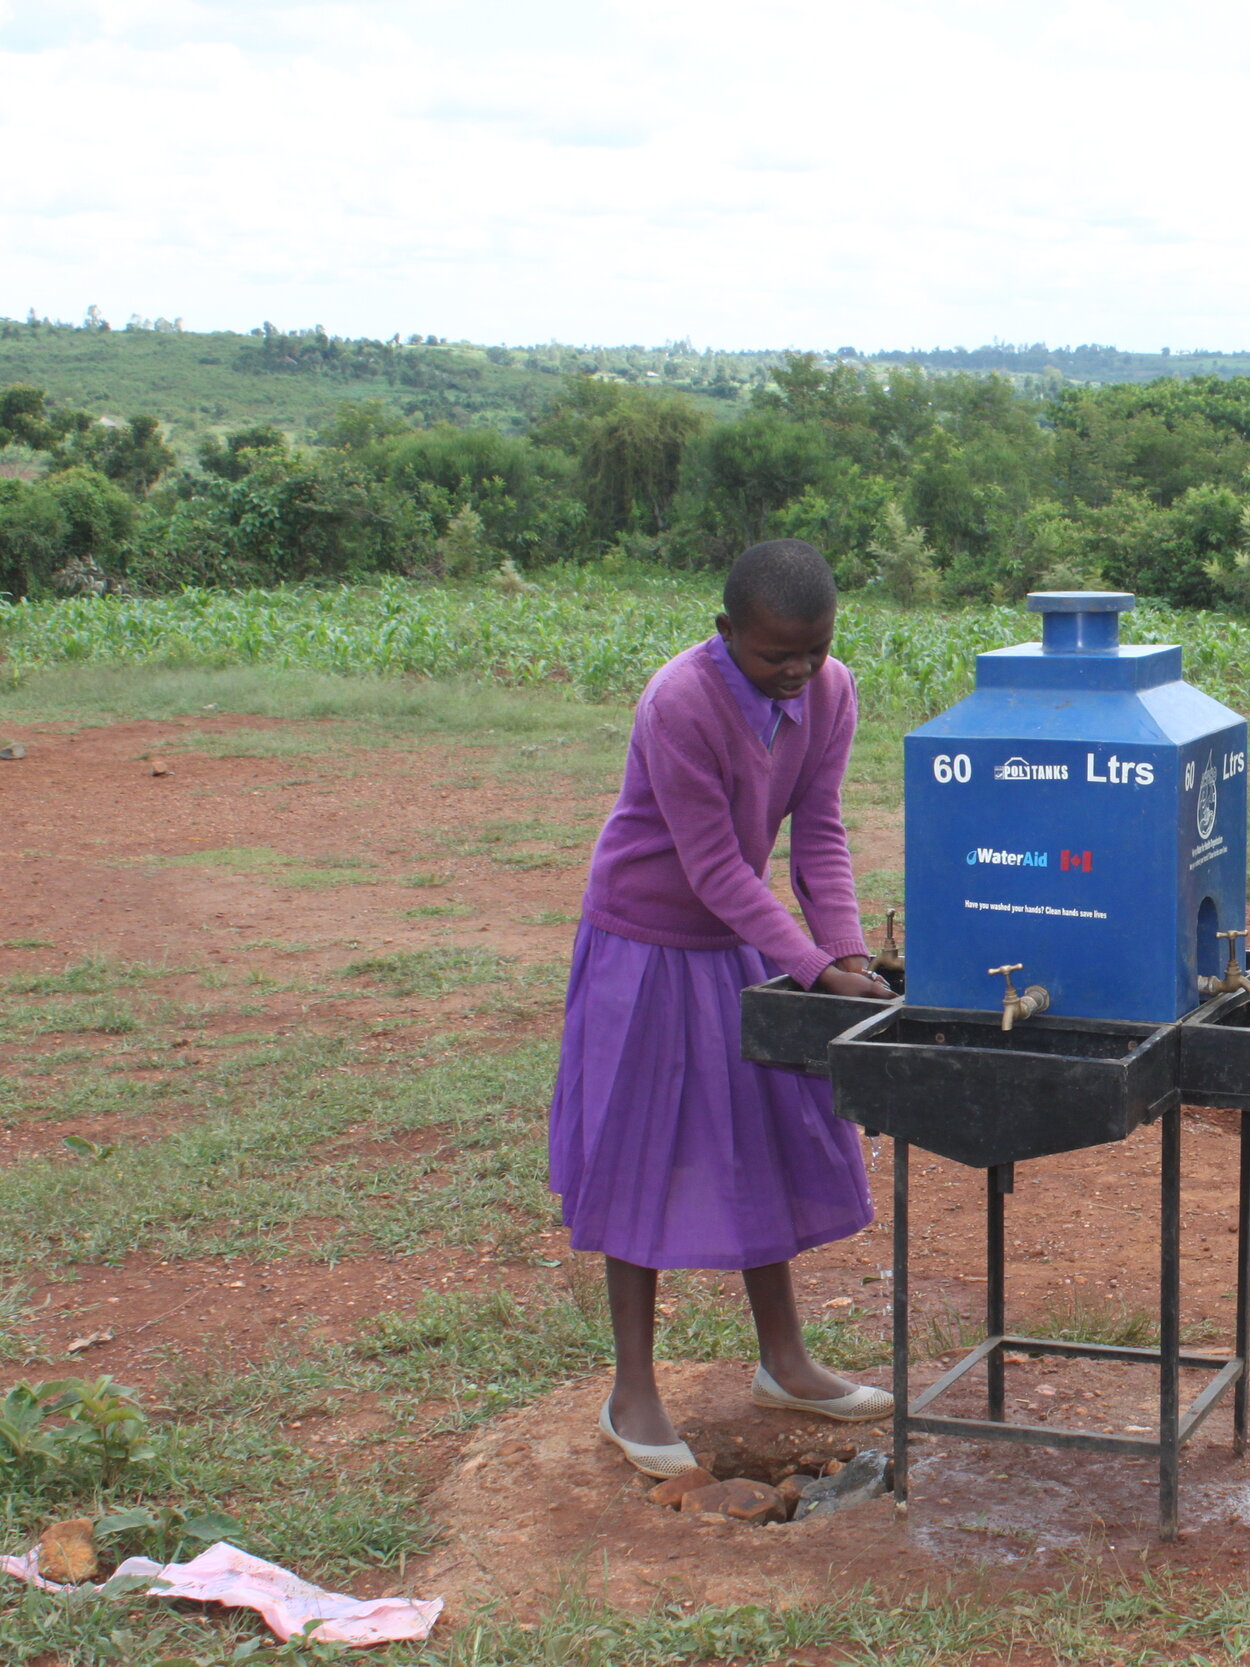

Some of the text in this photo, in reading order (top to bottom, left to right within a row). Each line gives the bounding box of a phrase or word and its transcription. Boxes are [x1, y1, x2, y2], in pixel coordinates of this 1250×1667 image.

[933, 753, 972, 783] 60
[1086, 752, 1154, 785] Ltrs
[1184, 761, 1195, 791] 60
[1223, 751, 1245, 780] Ltrs
[977, 848, 1048, 867] WaterAid
[964, 899, 1107, 919] Have you washed your hands? Clean hands save lives
